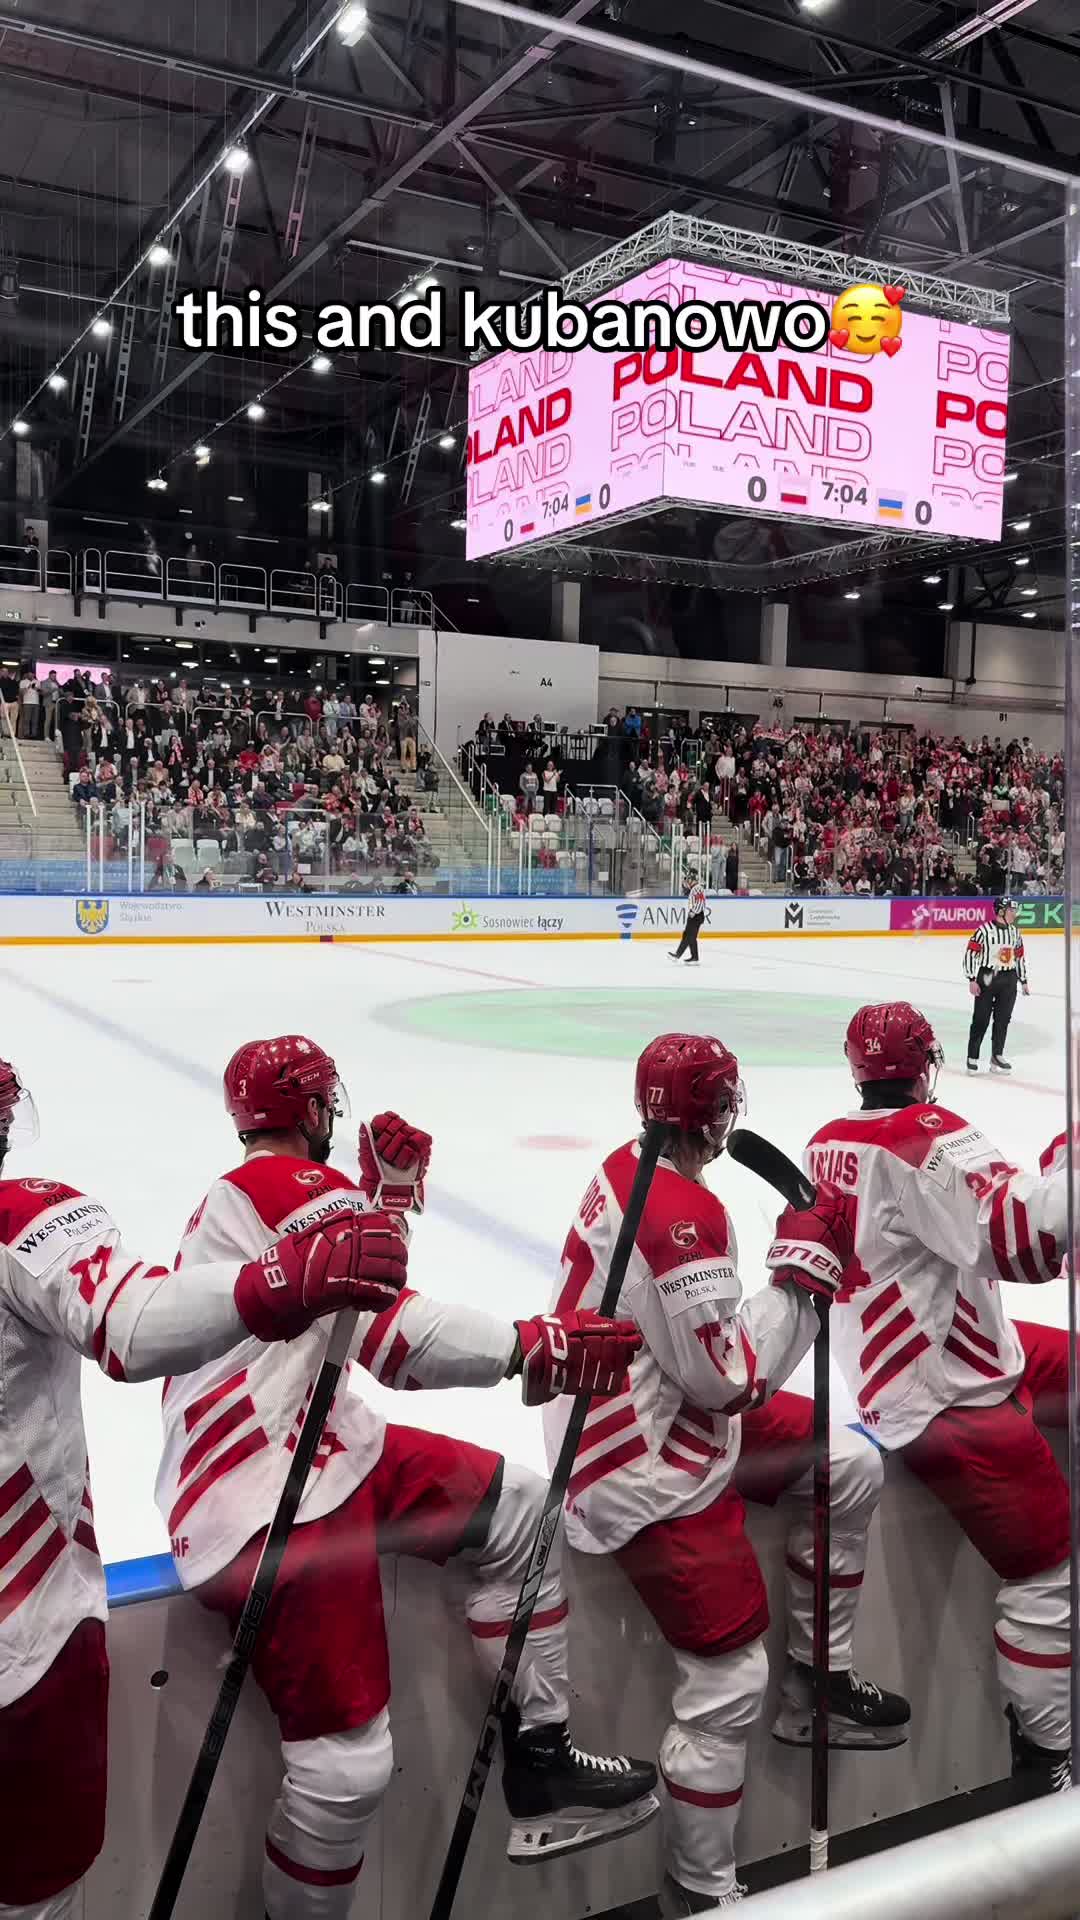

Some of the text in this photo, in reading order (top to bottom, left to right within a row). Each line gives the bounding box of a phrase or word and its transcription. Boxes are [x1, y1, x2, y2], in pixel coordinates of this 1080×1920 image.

[469, 349, 573, 421] LAND
[613, 345, 872, 414] POLAND
[610, 388, 872, 462] POLAND
[468, 433, 571, 507] LAND
[504, 519, 513, 542] 0
[542, 494, 569, 519] 7:04
[599, 483, 611, 509] 0
[748, 476, 932, 525] 0 7:04 0
[540, 677, 553, 687] A4
[482, 915, 564, 930] Sosnowiec łączy
[642, 906, 712, 925] ANMR
[932, 908, 986, 922] TAURON
[865, 1037, 881, 1052] 34
[239, 1079, 247, 1097] 3
[649, 1086, 665, 1104] 77
[927, 1131, 985, 1172] WESTMINSTE
[284, 1197, 365, 1234] WESTMINER
[660, 1267, 735, 1297] WESTMINSTER
